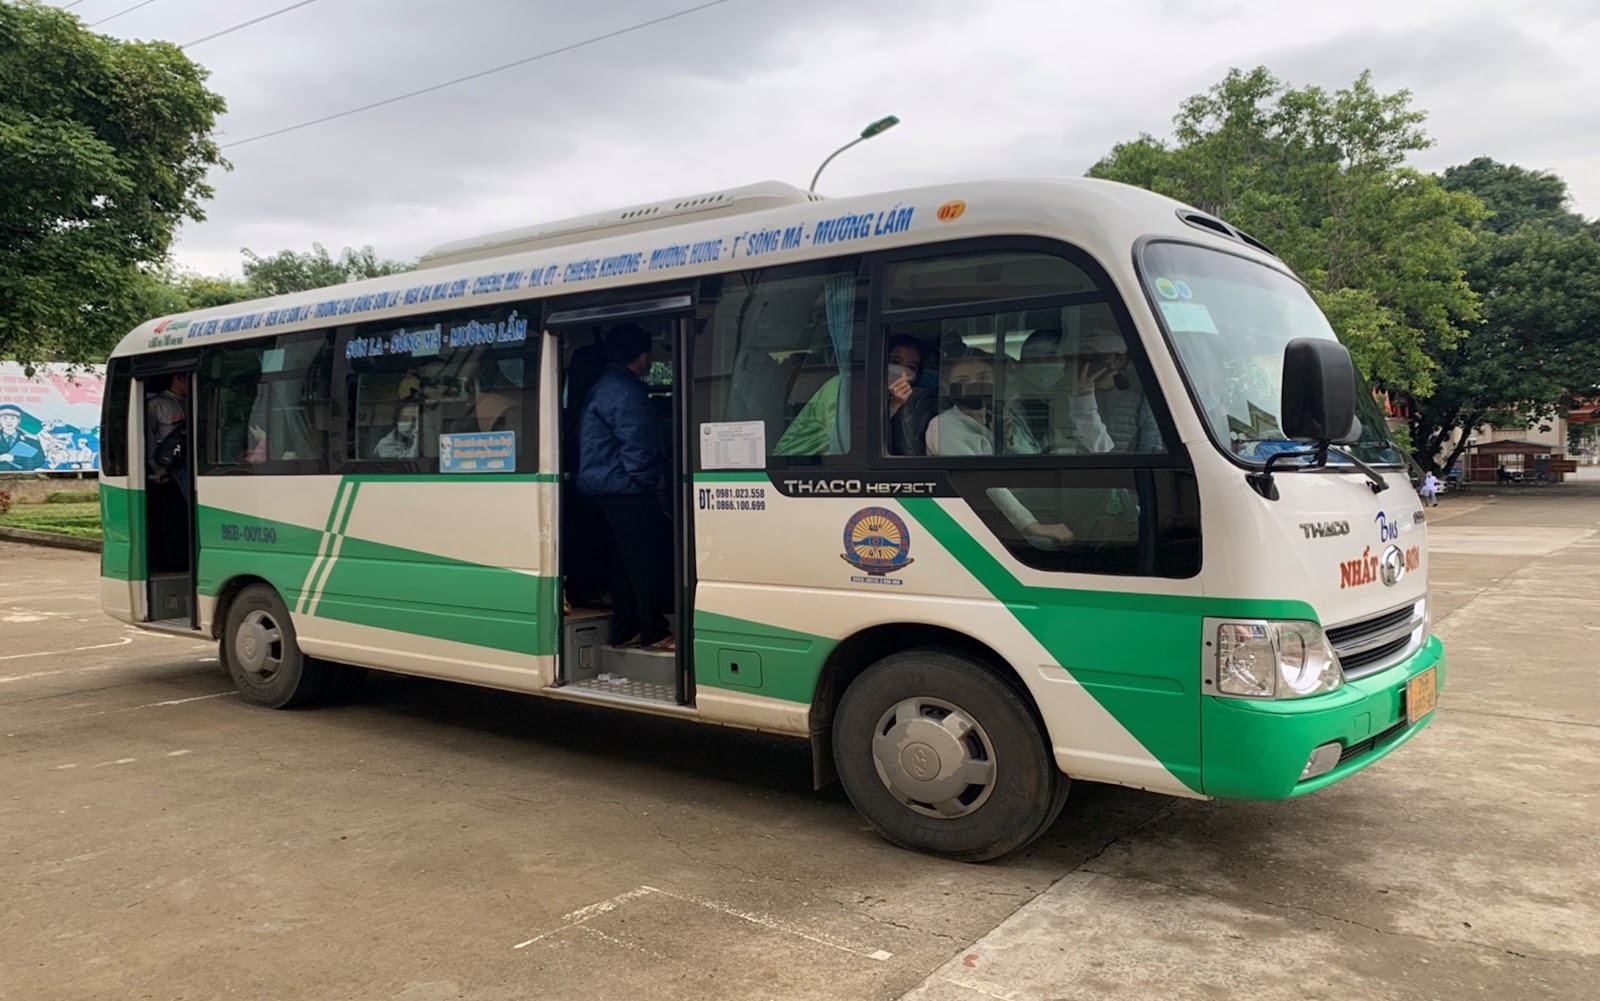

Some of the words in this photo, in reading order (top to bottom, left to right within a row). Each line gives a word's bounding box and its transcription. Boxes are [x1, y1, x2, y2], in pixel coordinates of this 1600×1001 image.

[941, 204, 960, 219] 07
[503, 270, 525, 291] MAI
[368, 337, 383, 356] LA
[716, 488, 765, 498] 0981.023.558
[783, 479, 861, 494] THACO
[866, 483, 937, 493] HB73CT
[1299, 520, 1350, 539] THACO
[1374, 511, 1399, 543] Bus
[1339, 545, 1379, 589] NHẤT
